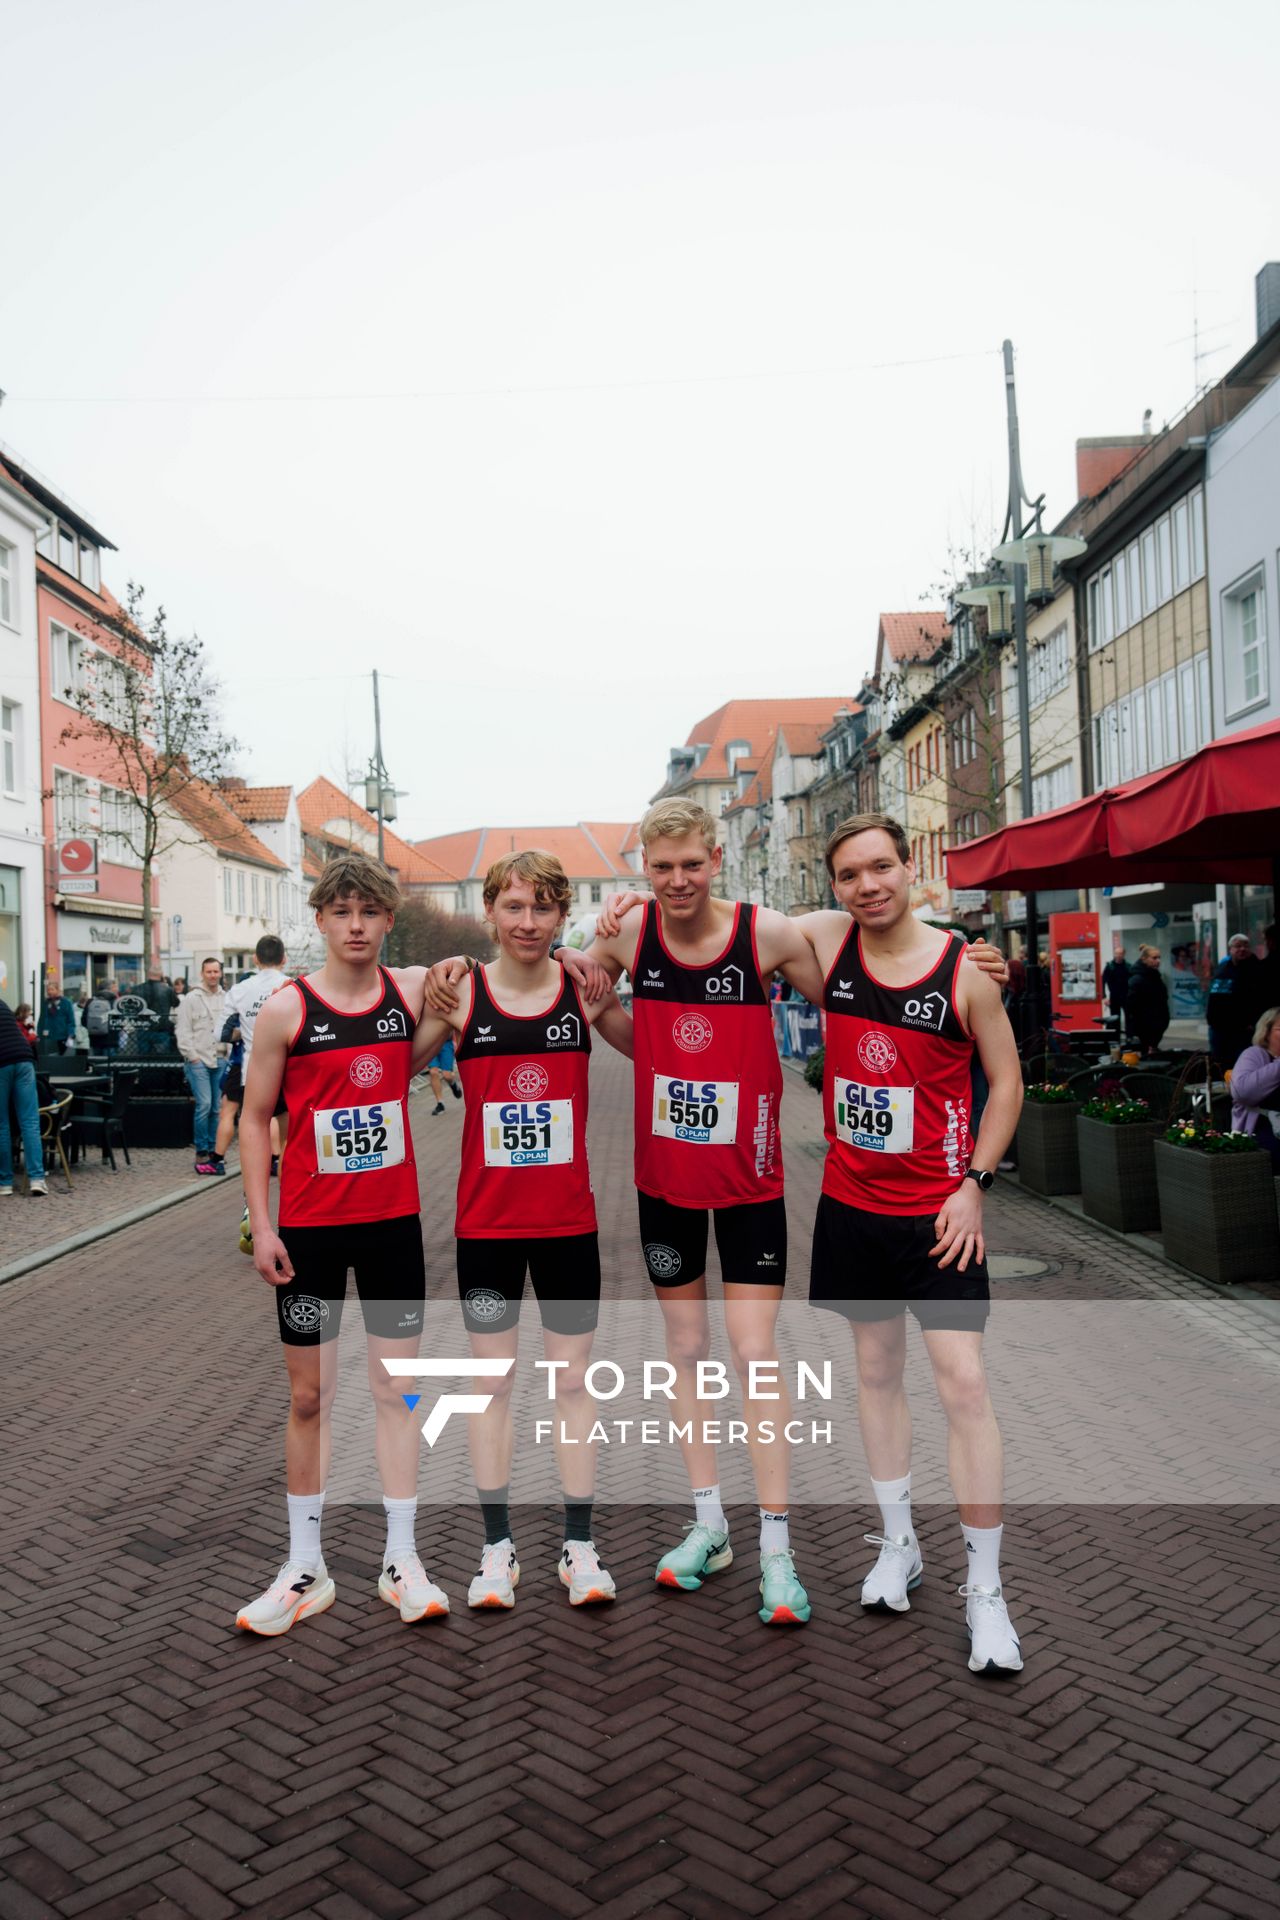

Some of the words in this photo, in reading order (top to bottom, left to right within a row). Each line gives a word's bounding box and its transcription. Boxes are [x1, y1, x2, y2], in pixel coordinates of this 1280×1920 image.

[643, 979, 664, 988] erima
[705, 977, 732, 994] OS
[832, 989, 854, 1000] erima
[904, 999, 934, 1020] OS
[376, 1017, 399, 1034] OS
[310, 1033, 336, 1043] erima
[546, 1024, 572, 1041] OS
[474, 1035, 497, 1044] erima
[669, 1099, 719, 1128] 550
[847, 1103, 893, 1136] 549
[503, 1123, 551, 1150] 551
[688, 1130, 709, 1138] PLAN
[336, 1126, 388, 1157] 552
[864, 1136, 884, 1146] PLAN
[361, 1155, 381, 1165] PLAN
[526, 1151, 547, 1159] PLAN
[398, 1318, 420, 1327] erima
